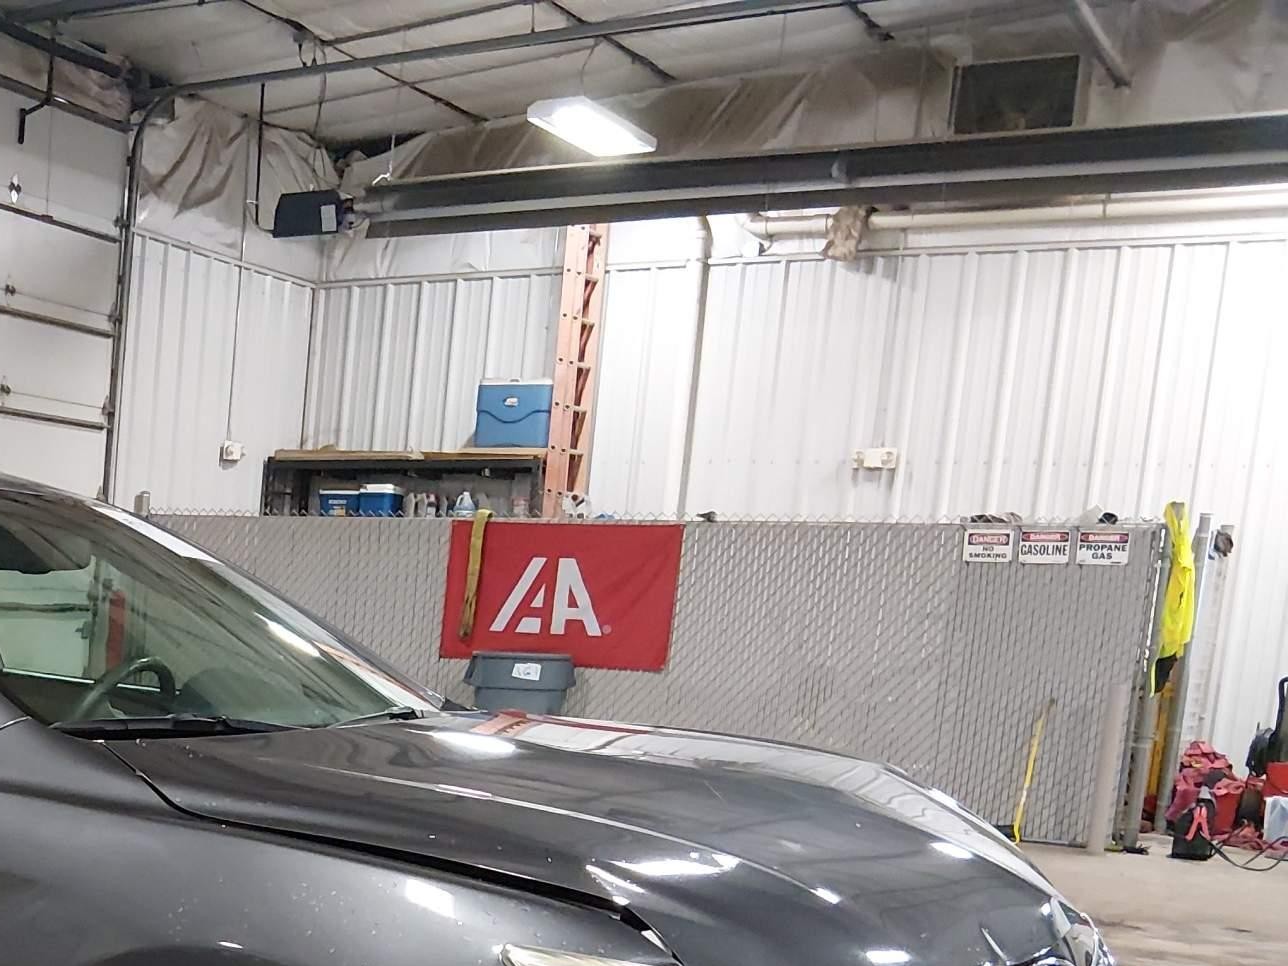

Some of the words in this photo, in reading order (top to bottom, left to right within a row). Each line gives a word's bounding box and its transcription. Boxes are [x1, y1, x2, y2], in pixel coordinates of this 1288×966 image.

[1020, 544, 1068, 556] GASOLINE
[1079, 543, 1128, 552] PROPANE
[1091, 552, 1113, 560] GAS
